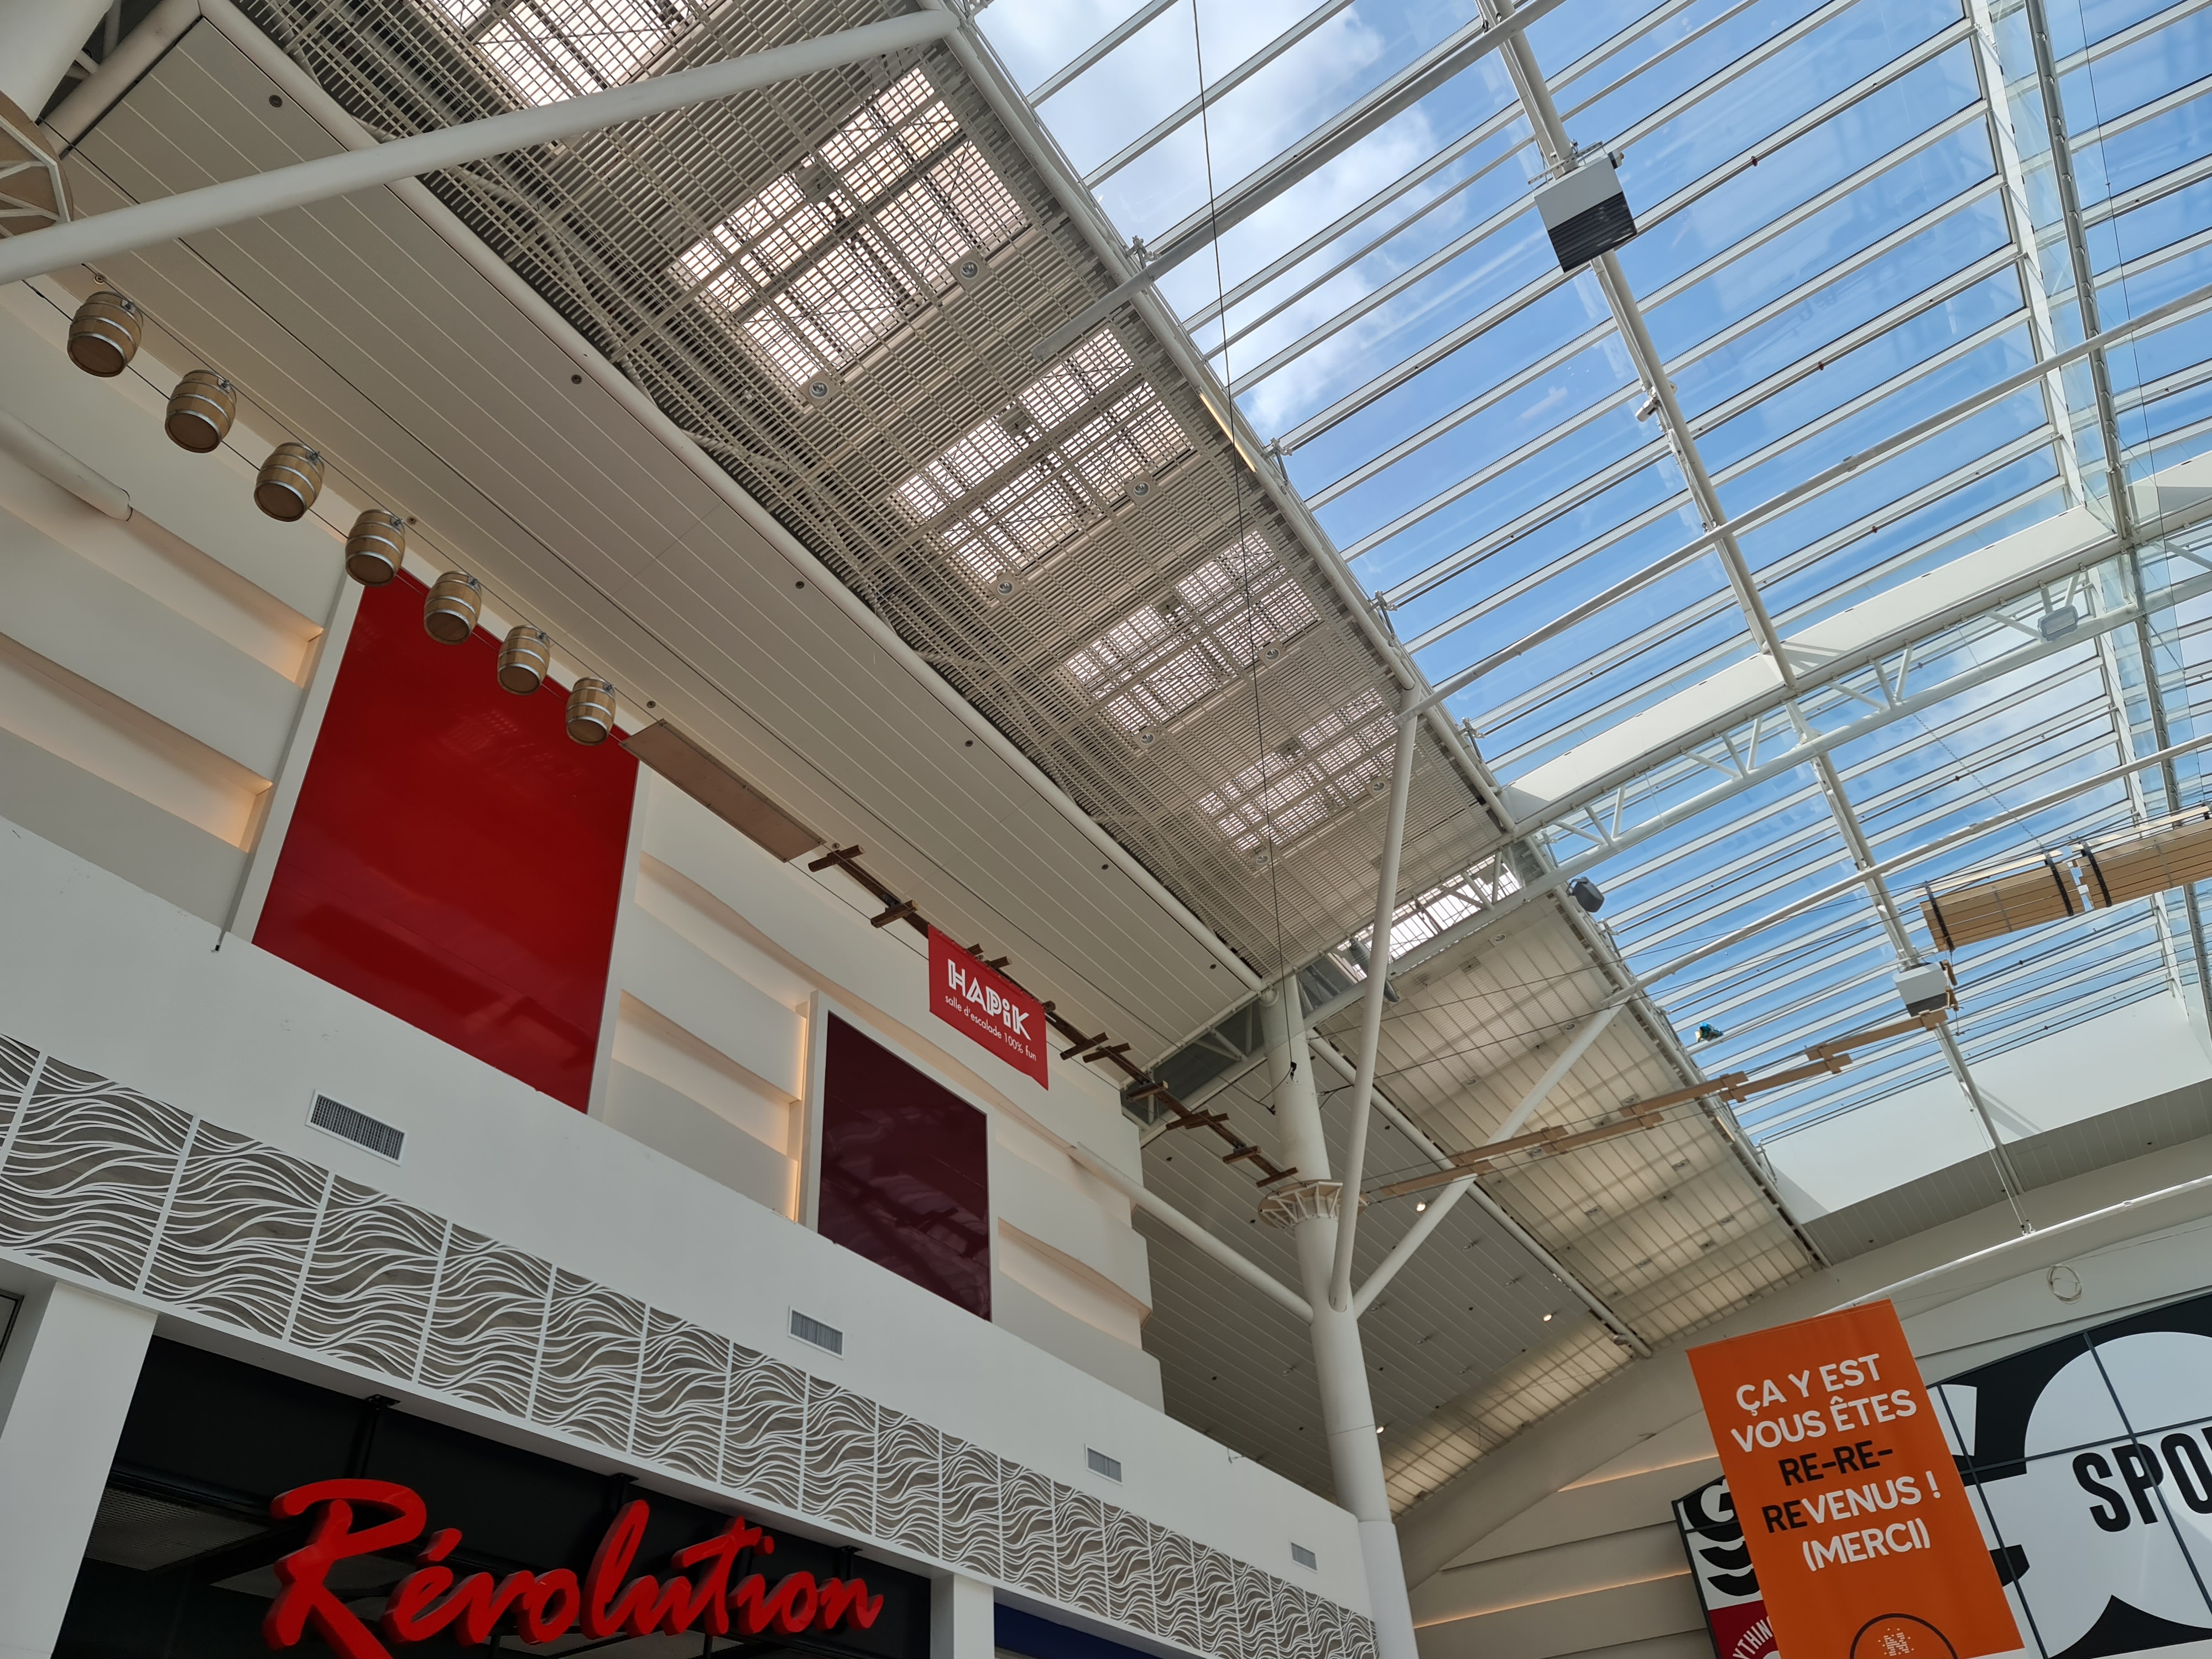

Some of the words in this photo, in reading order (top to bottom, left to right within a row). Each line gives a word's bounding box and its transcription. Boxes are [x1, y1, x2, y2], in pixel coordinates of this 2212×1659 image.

[945, 995, 962, 1012] salle
[964, 1006, 1002, 1039] d'escalade
[1004, 1032, 1023, 1053] 100%
[1025, 1045, 1037, 1061] fun
[1736, 1379, 1787, 1416] ÇA
[1788, 1370, 1810, 1397] Y
[1819, 1353, 1880, 1392] EST
[1731, 1411, 1827, 1453] VOUS
[1829, 1389, 1916, 1432] ÊTES
[1778, 1440, 1893, 1486] RE-RE-
[2073, 1426, 2212, 1532] SPO
[1761, 1476, 1922, 1533] REVENUS
[263, 1479, 884, 1659] Révolution
[1802, 1518, 1930, 1571] (MERCI)
